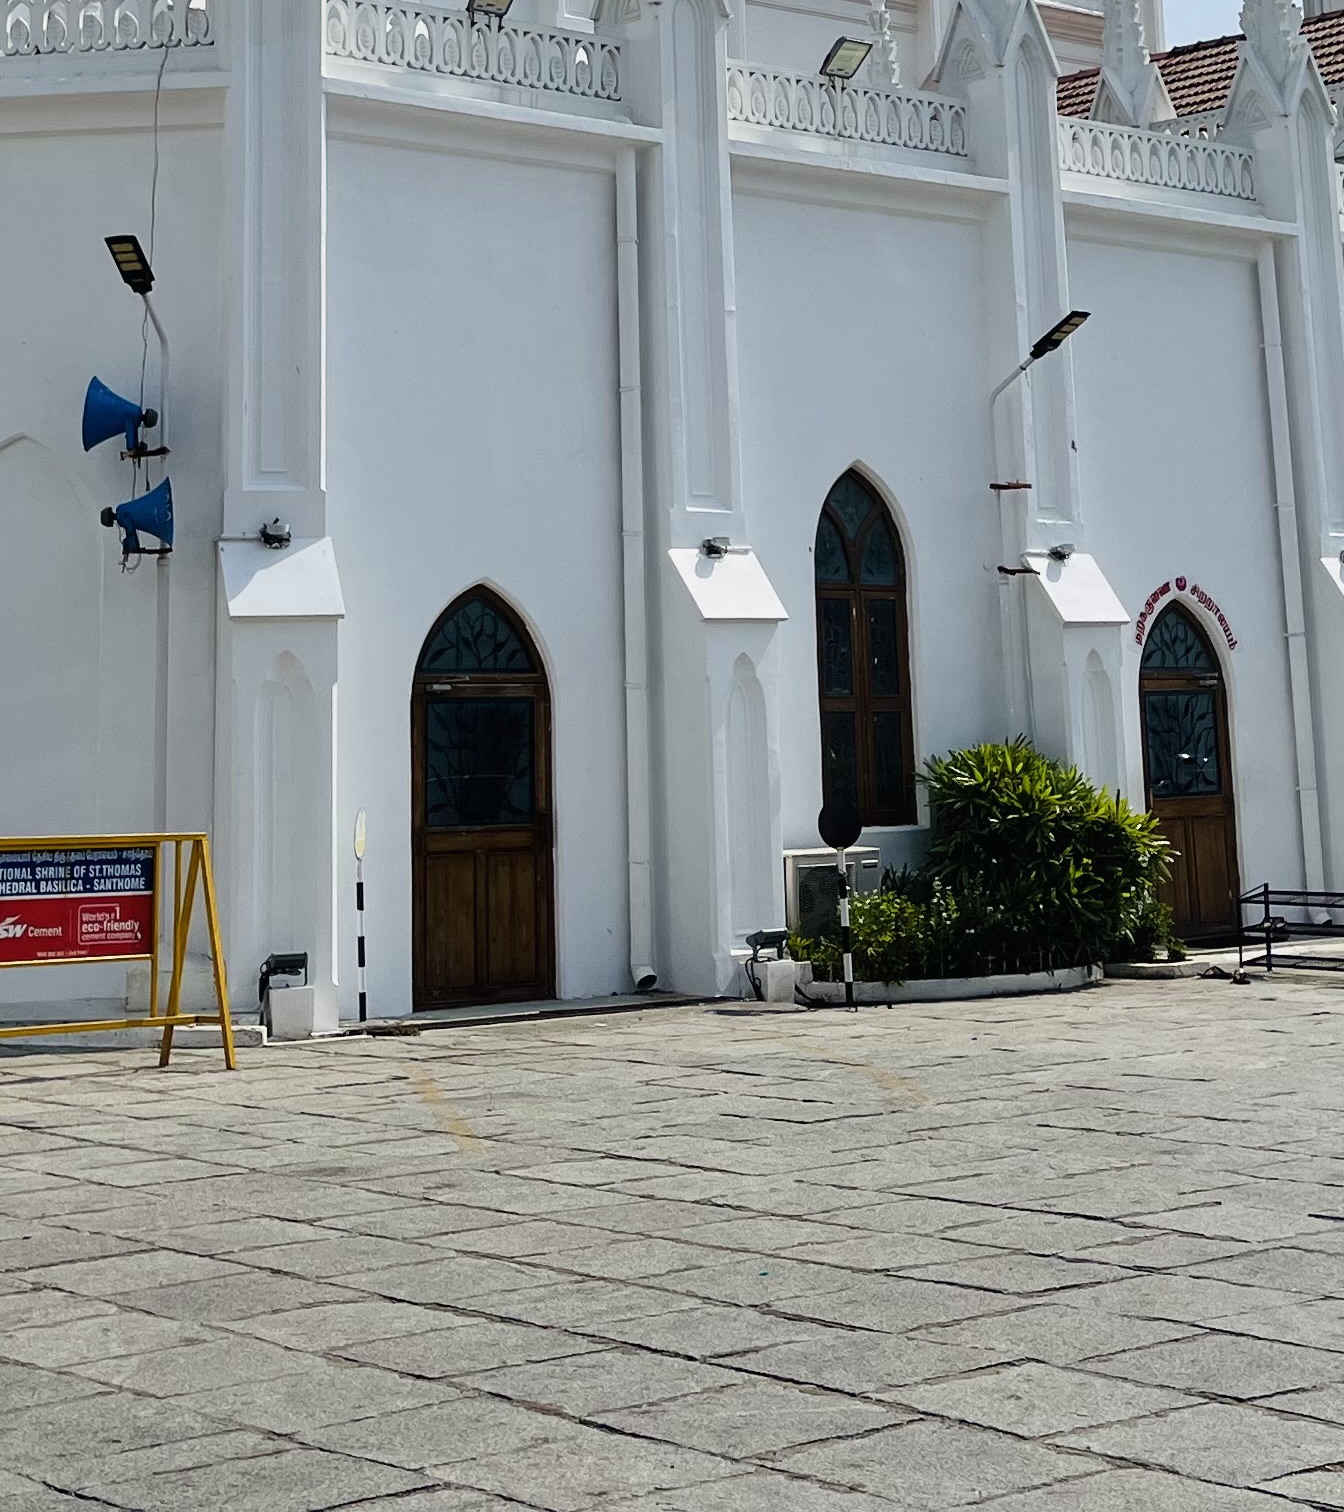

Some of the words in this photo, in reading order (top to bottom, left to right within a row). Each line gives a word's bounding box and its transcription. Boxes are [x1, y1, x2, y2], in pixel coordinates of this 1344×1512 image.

[35, 866, 71, 880] SHRINE
[73, 865, 87, 878] OF
[39, 879, 84, 893] BASILICA
[93, 877, 146, 890] SANTHOME
[81, 912, 110, 922] World's
[28, 925, 63, 937] Cement
[81, 919, 140, 933] eco-friendly
[81, 932, 106, 941] cement
[107, 931, 136, 940] company
